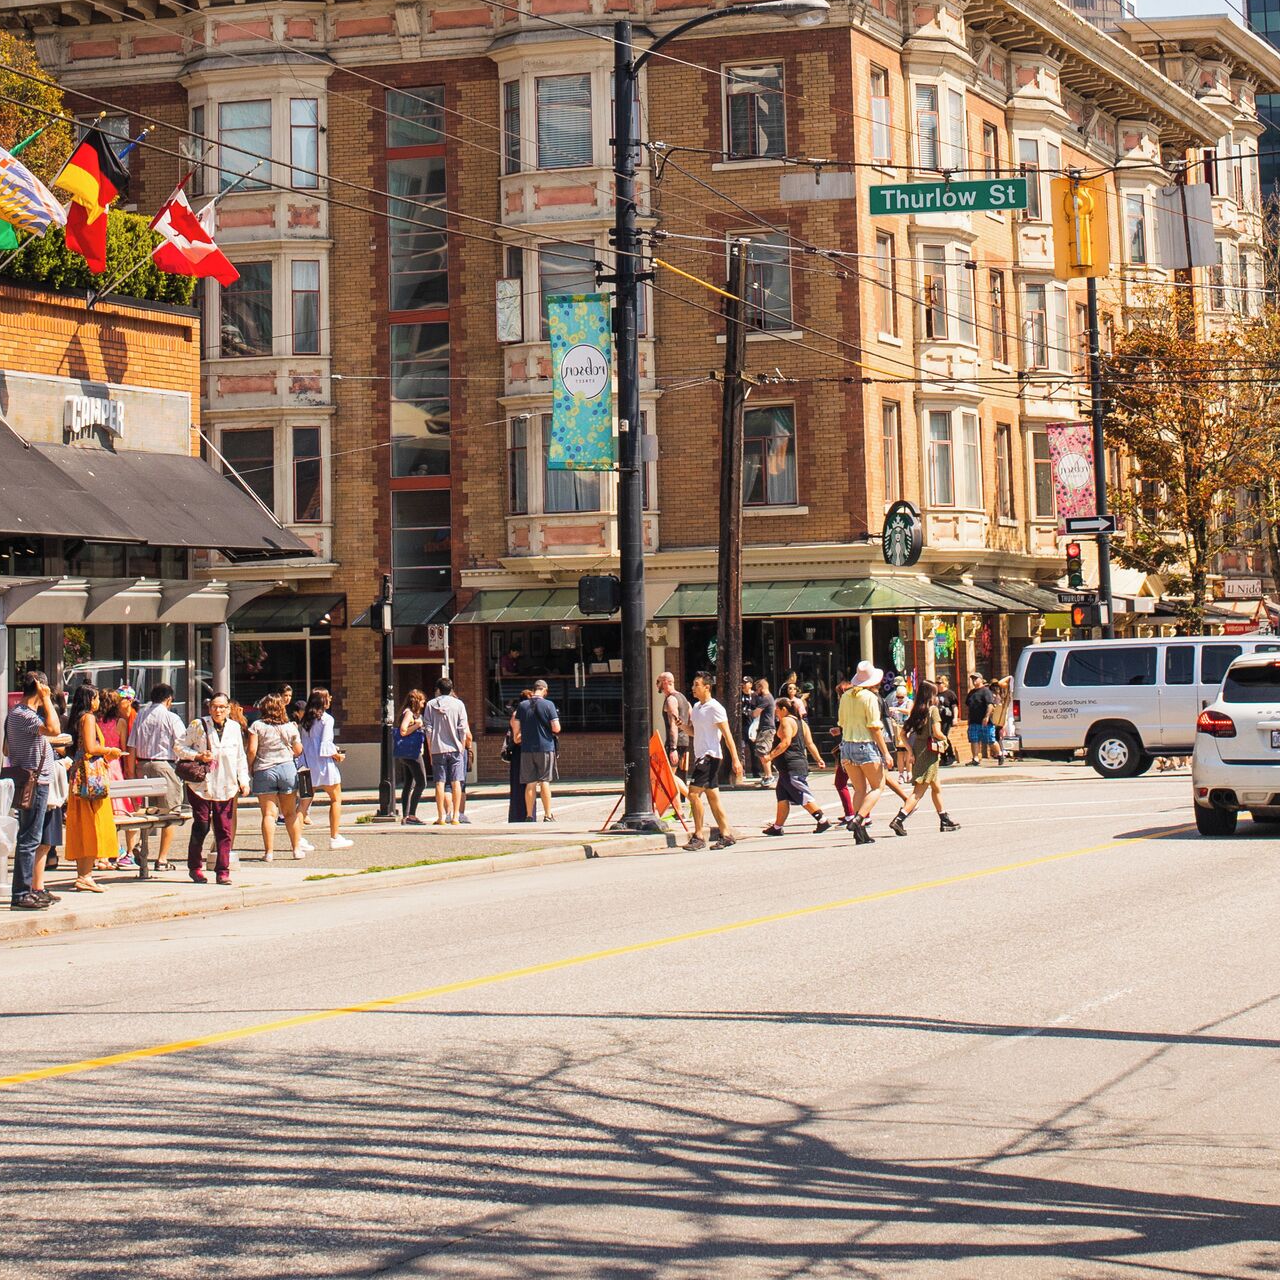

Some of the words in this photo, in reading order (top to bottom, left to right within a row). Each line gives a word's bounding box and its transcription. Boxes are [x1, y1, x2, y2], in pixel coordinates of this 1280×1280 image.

[880, 188, 977, 210] Thurlow
[989, 184, 1016, 205] St
[68, 395, 125, 438] CAMPER
[1238, 583, 1261, 594] Nido
